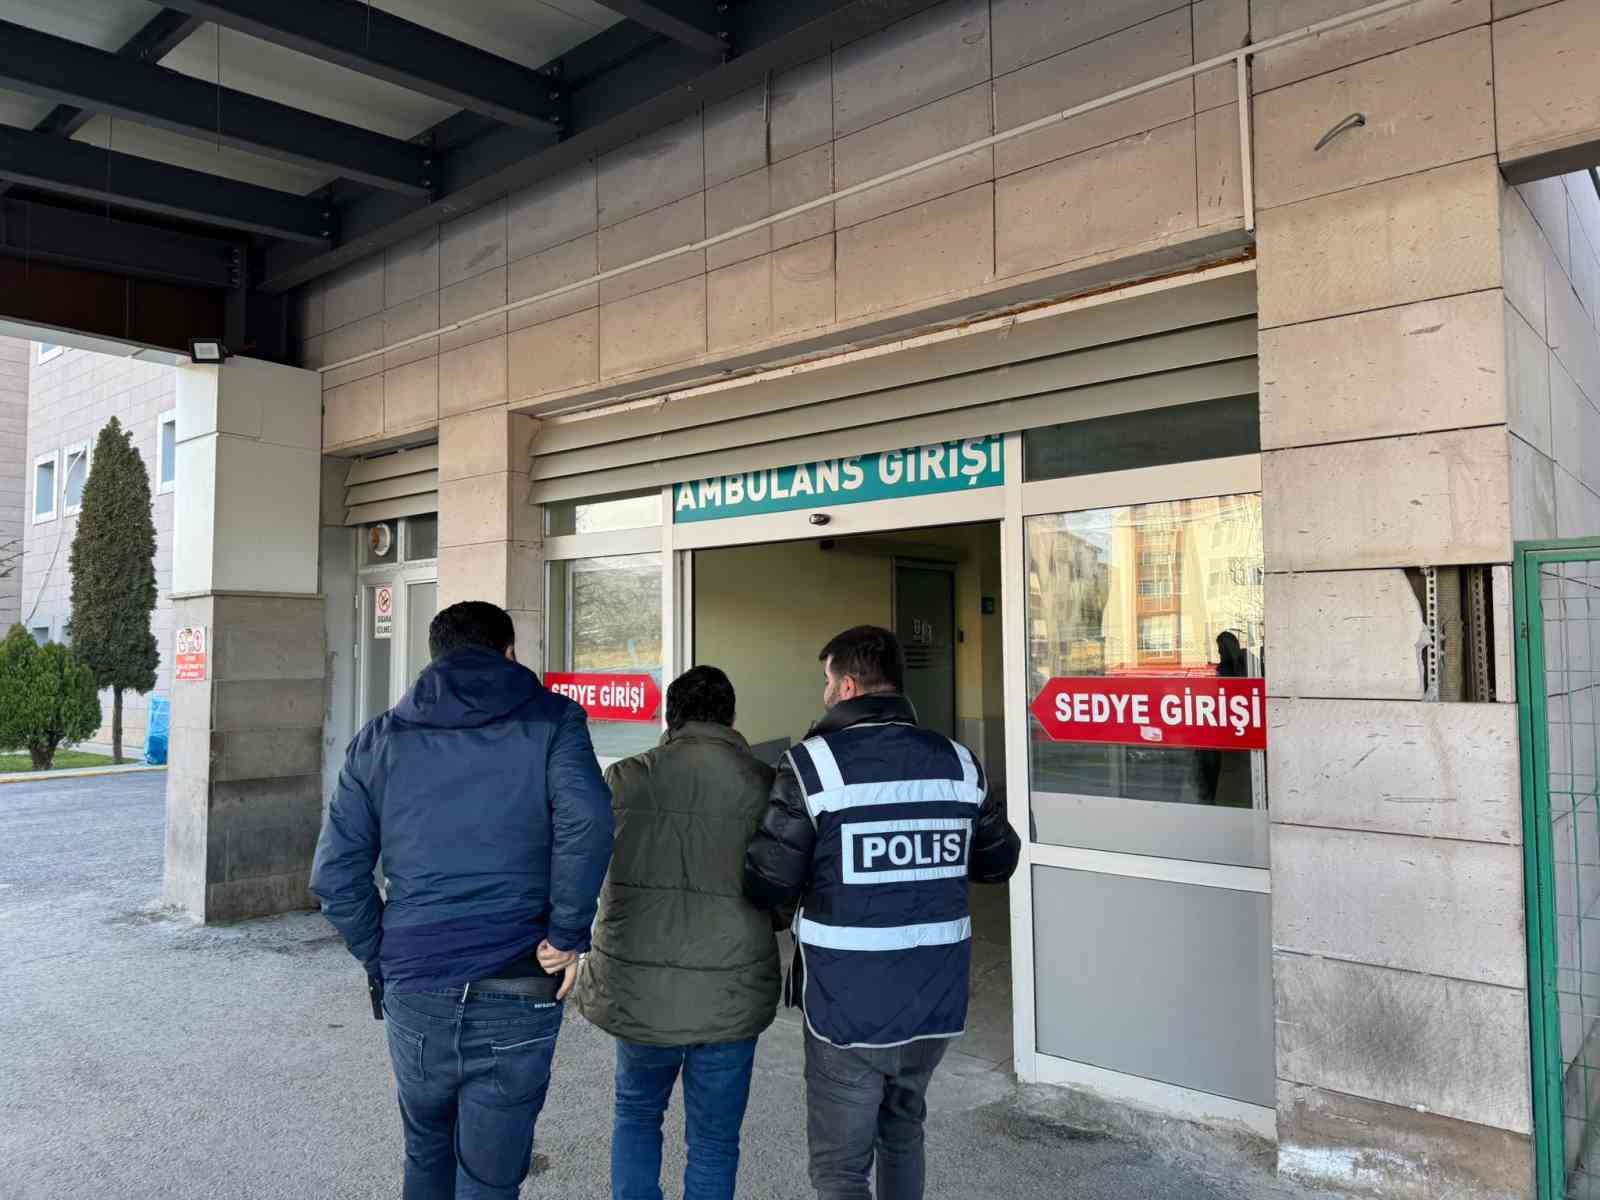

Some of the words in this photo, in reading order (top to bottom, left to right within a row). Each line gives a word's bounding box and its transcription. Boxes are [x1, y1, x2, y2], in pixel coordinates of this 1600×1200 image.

[676, 458, 864, 512] AMBULANS
[879, 432, 1001, 486] GİRİŞİ
[600, 680, 645, 714] GİRİŞİ
[1055, 692, 1149, 725] SEDYE
[1160, 687, 1261, 736] GİRİŞİ
[862, 833, 961, 868] POLİS
